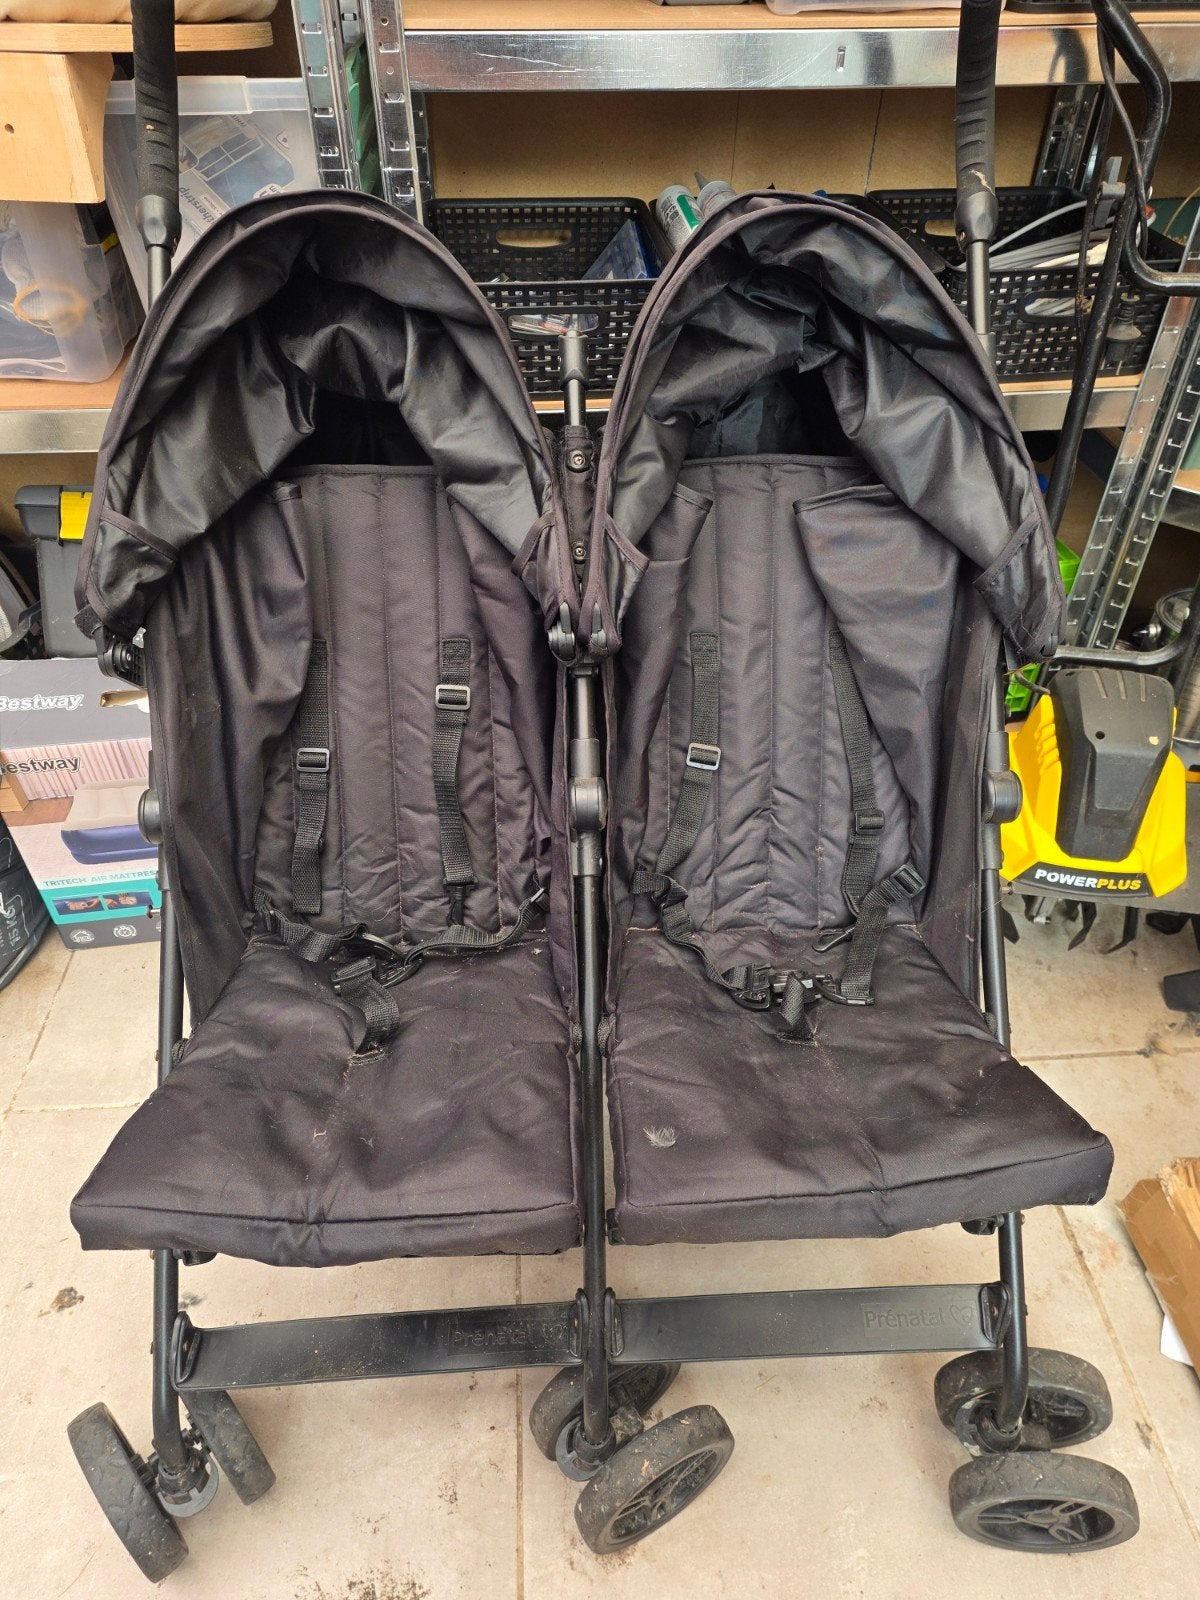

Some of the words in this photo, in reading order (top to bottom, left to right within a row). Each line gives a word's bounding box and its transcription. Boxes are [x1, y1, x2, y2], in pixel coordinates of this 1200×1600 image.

[180, 187, 216, 223] therstrip
[43, 877, 87, 887] TRITECH
[91, 874, 108, 883] AIR
[111, 870, 156, 880] MATTRES
[1035, 868, 1141, 890] POWERPLUS
[864, 1307, 944, 1328] Prénatal
